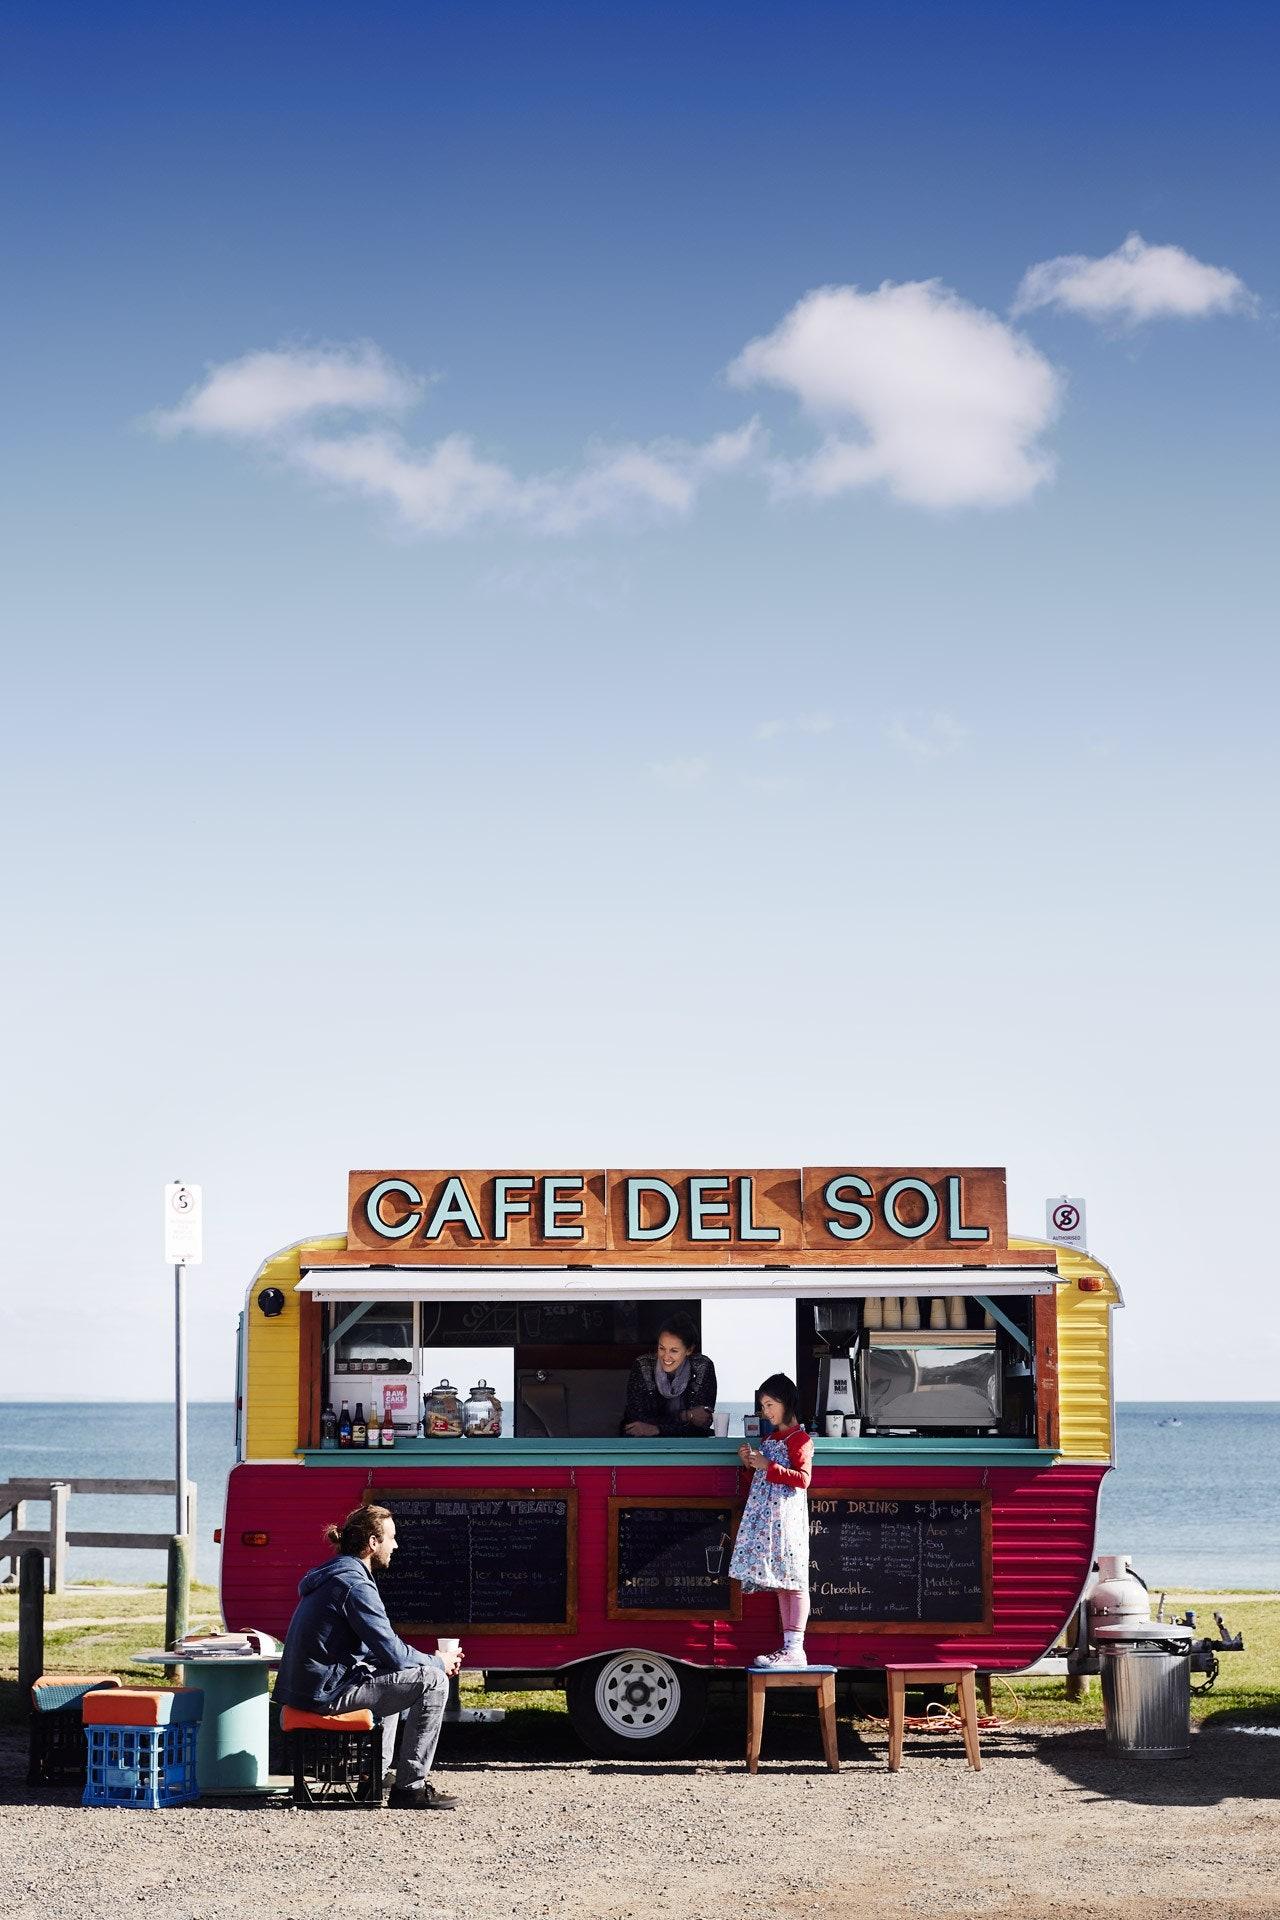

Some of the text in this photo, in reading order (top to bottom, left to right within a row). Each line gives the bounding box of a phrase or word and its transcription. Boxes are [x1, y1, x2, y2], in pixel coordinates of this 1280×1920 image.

[365, 1173, 991, 1242] CAFE DEL SOL
[435, 1501, 504, 1516] HEALTHY
[507, 1501, 567, 1516] TREATS
[810, 1500, 838, 1513] HOT
[847, 1500, 899, 1515] DRINKS
[808, 1519, 830, 1537] ffee
